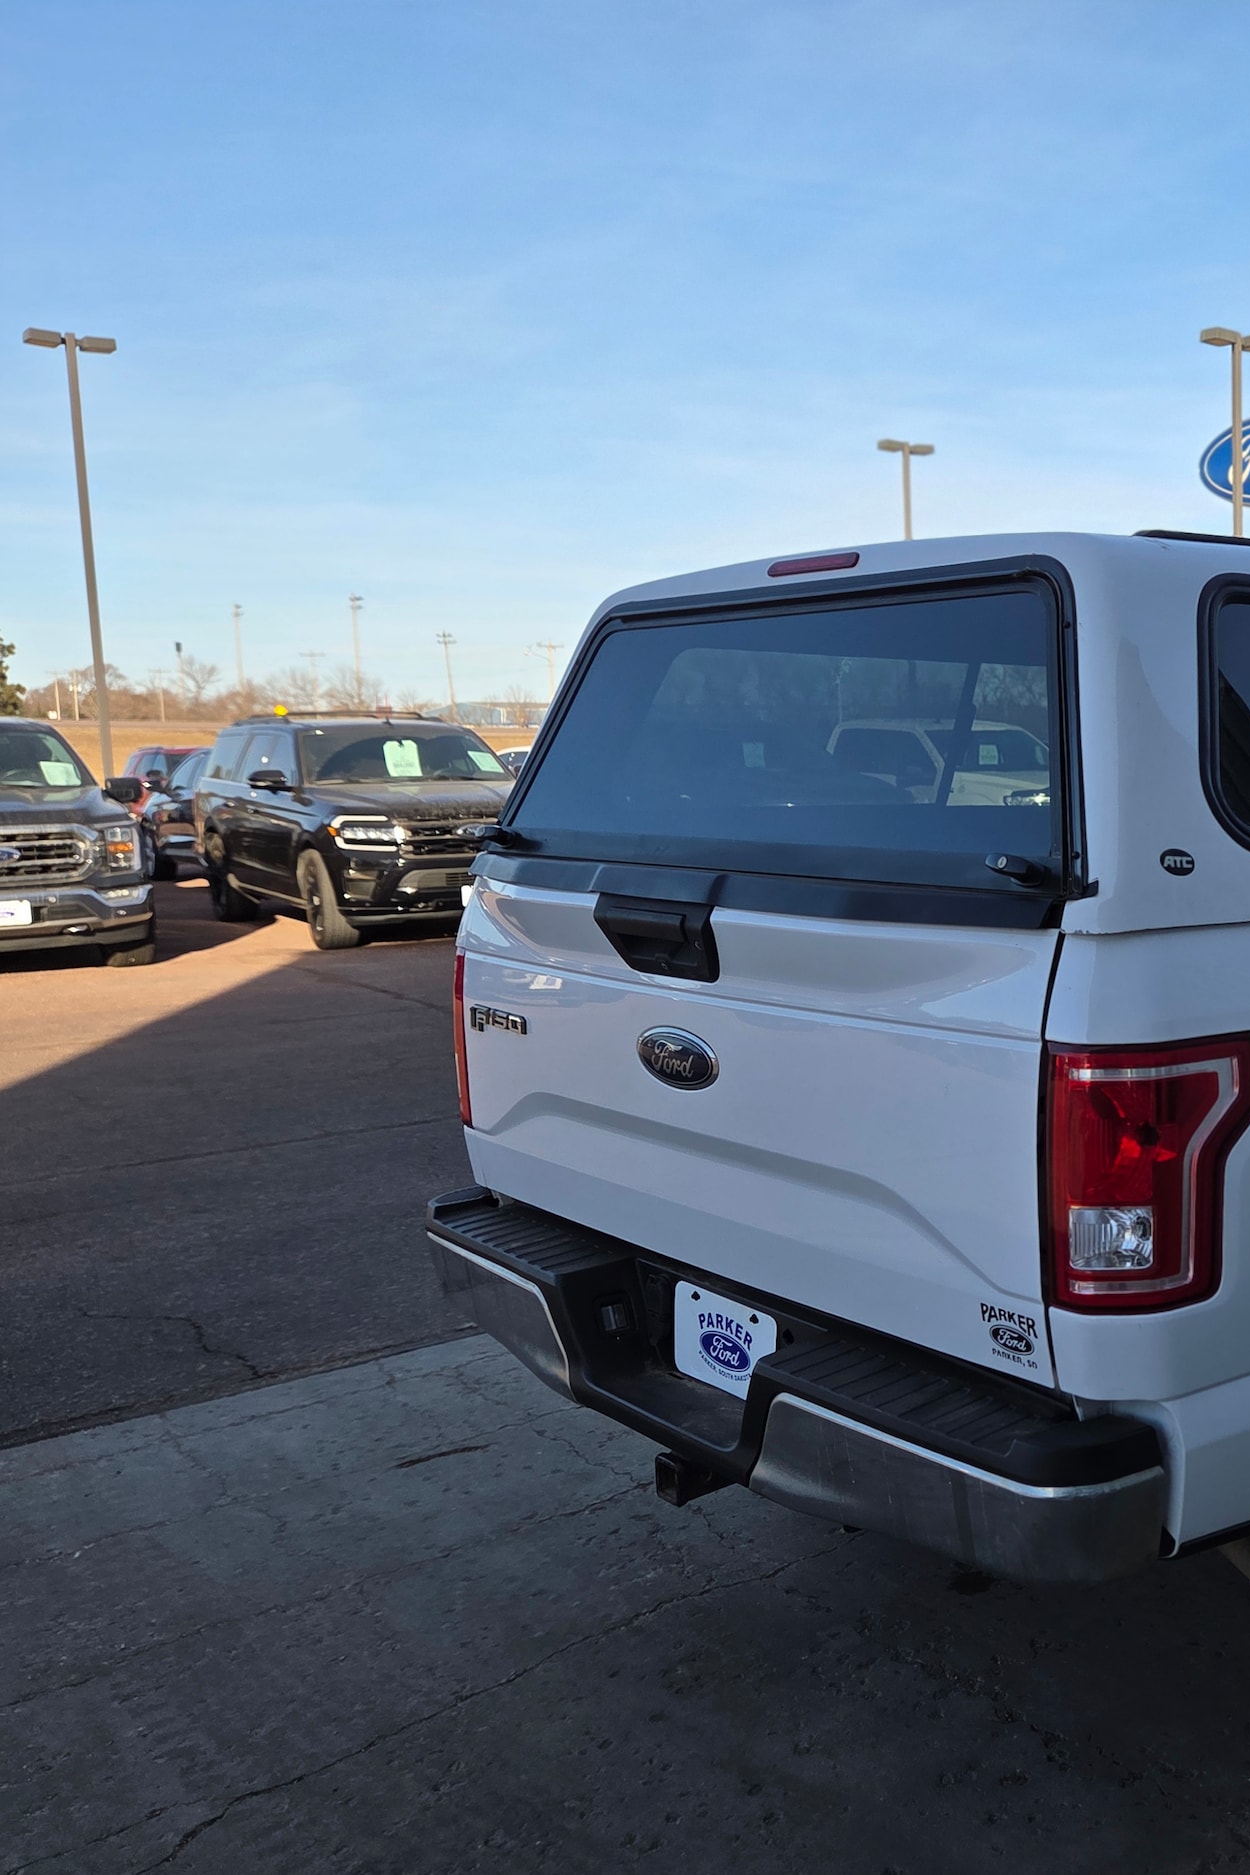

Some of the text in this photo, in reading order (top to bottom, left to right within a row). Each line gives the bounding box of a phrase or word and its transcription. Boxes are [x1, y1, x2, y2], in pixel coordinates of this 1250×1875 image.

[651, 1039, 694, 1078] Ford
[698, 1312, 753, 1351] PARKER
[980, 1302, 1038, 1339] PARKER
[710, 1335, 740, 1366] Ford
[997, 1328, 1027, 1351] Ford
